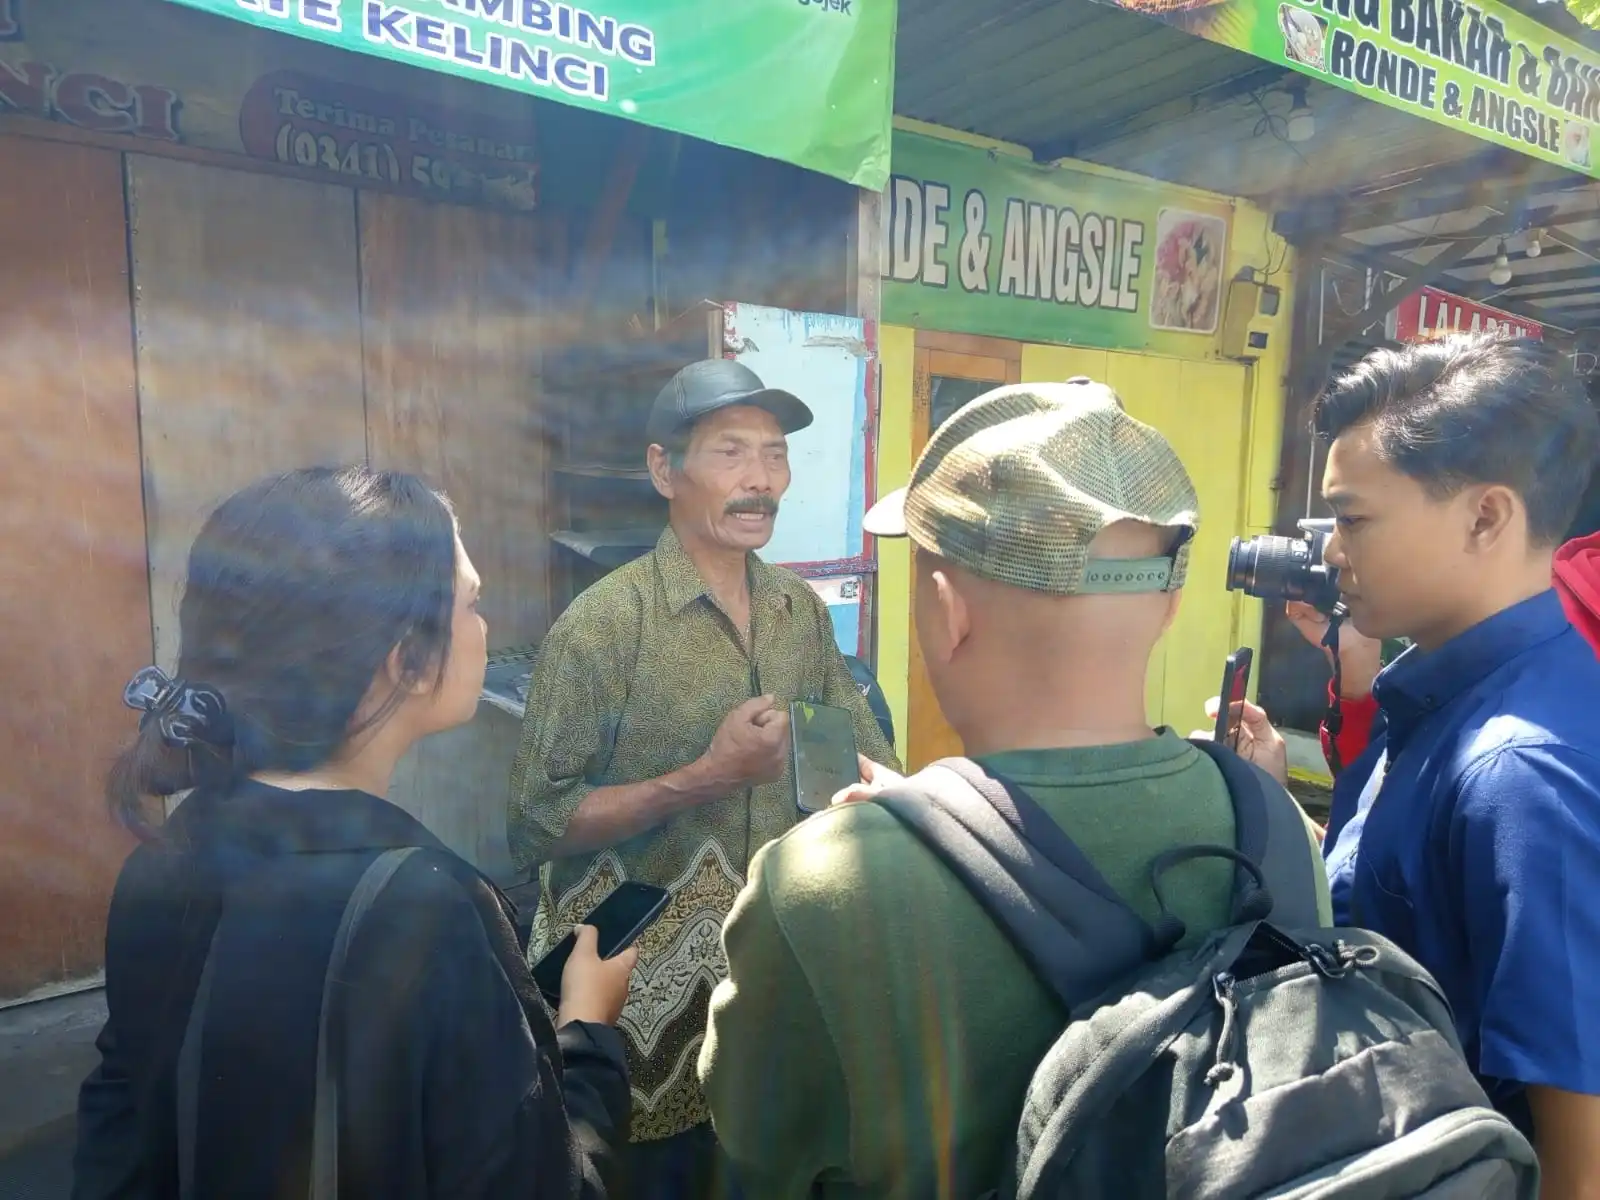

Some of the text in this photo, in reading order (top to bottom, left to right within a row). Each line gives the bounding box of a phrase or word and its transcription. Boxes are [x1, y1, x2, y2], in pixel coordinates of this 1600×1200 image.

[364, 1, 608, 100] KELINCI
[1330, 28, 1560, 155] RONDE & ANGSLE
[1389, 0, 1513, 87] BAKAR
[1516, 42, 1543, 99] &
[273, 86, 396, 136] Terima
[957, 187, 992, 293] &
[997, 198, 1144, 313] ANGSLE
